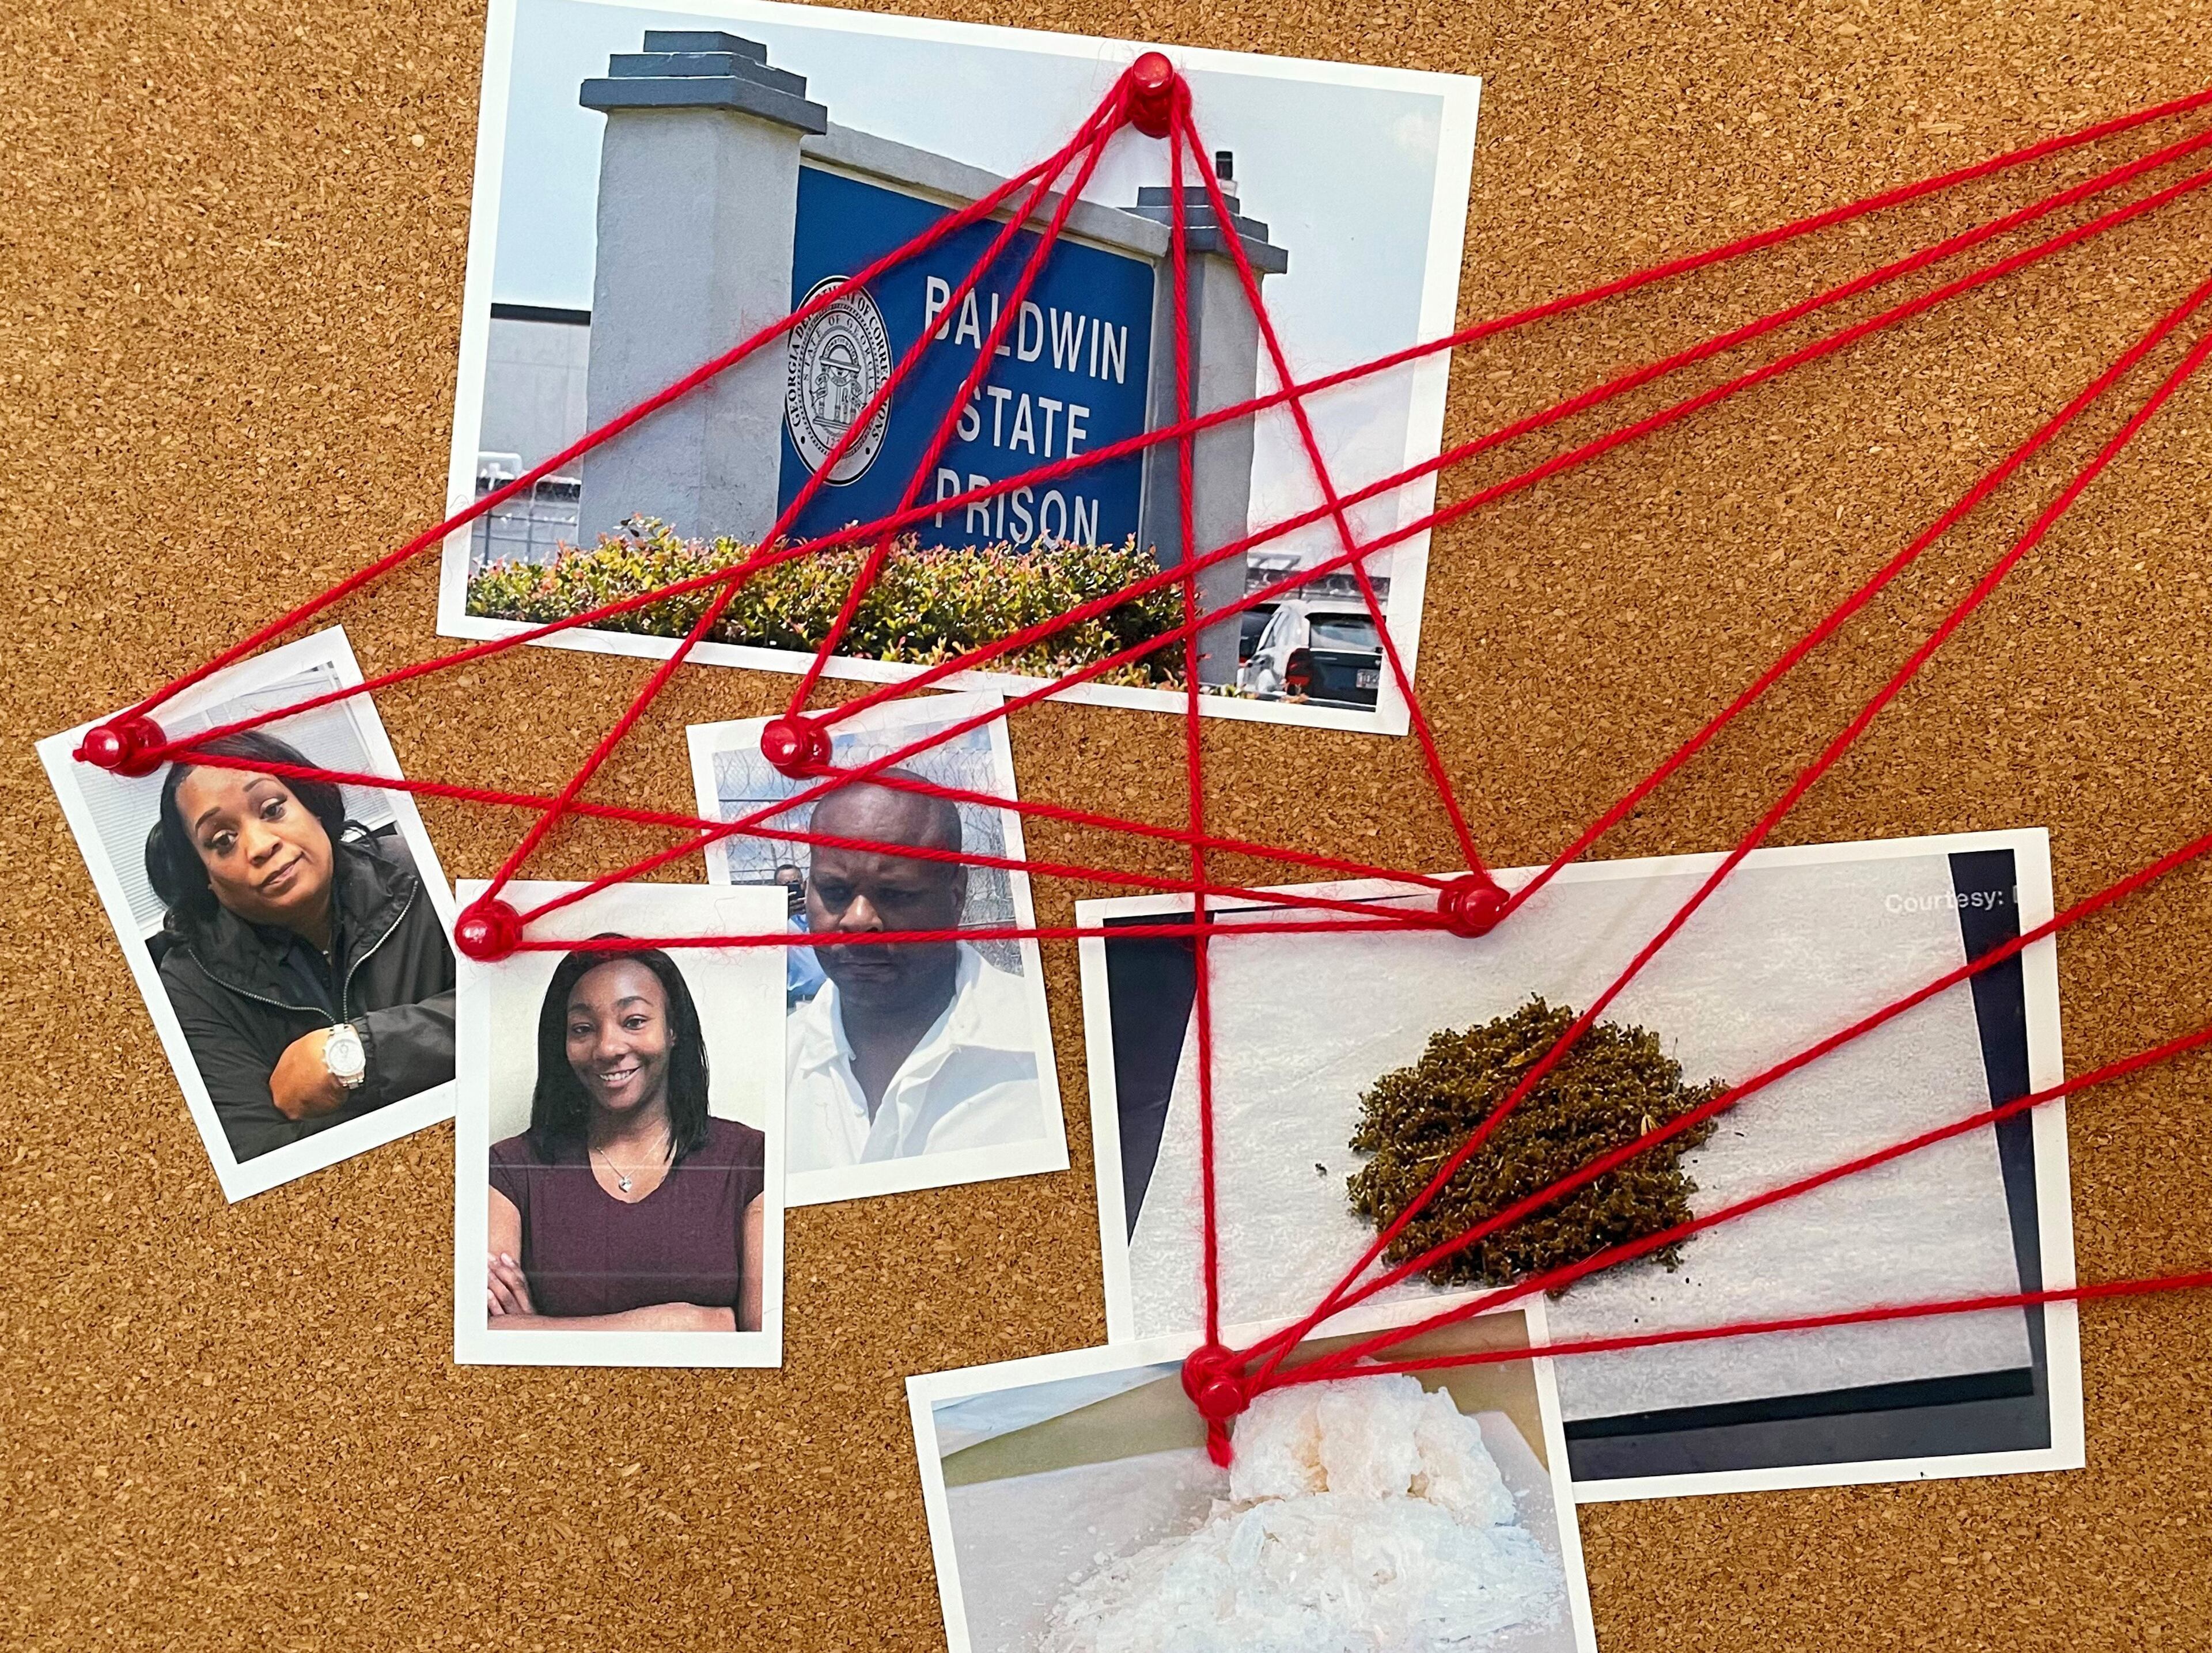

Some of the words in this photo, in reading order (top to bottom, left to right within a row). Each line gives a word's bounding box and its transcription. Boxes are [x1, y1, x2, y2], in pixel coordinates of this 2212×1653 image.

[828, 314, 840, 326] OF
[925, 275, 1127, 384] BALDWIN
[787, 344, 801, 427] GEORGIA
[858, 297, 872, 317] OF
[956, 379, 1090, 460] STATE
[935, 468, 1099, 549] PRISON
[1885, 890, 2003, 913] Courtesy:
